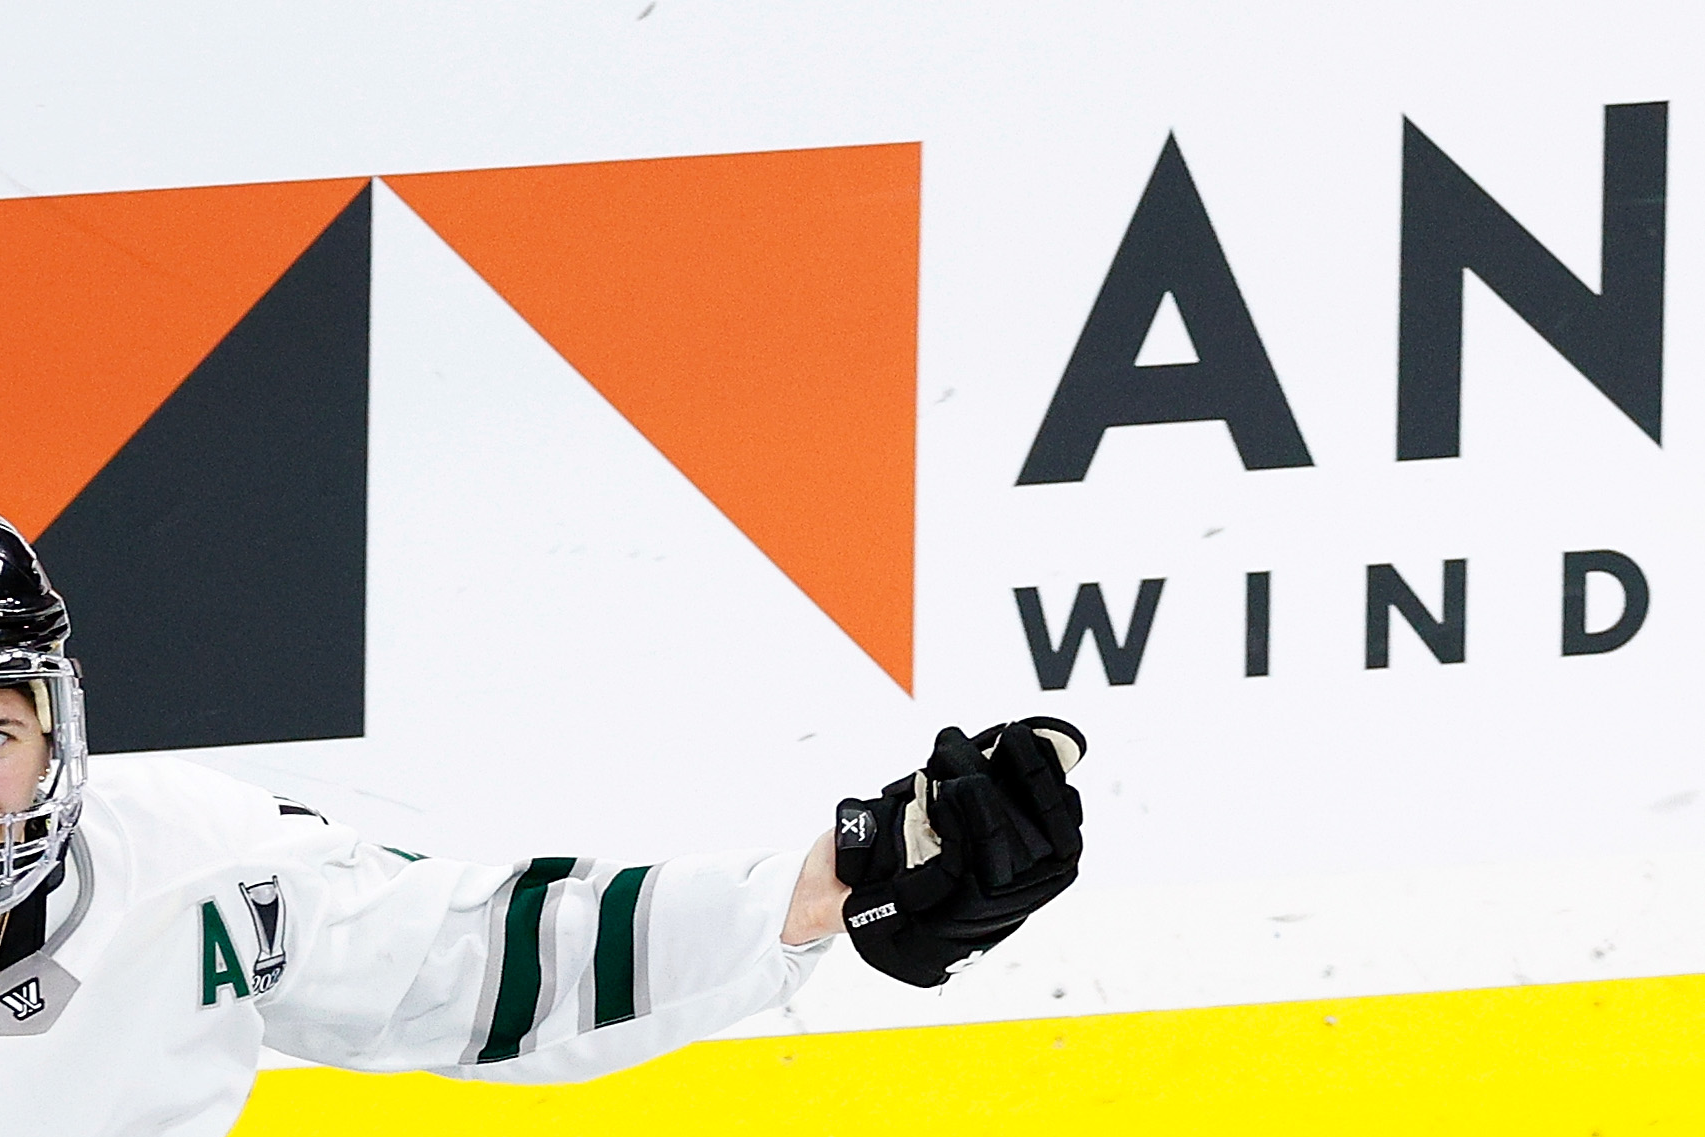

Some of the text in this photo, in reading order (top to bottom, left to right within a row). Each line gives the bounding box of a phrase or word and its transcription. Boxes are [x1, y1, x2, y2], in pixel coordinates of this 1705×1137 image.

[1015, 101, 1669, 486] AN
[1013, 549, 1650, 691] WIND
[197, 896, 251, 1008] A
[848, 902, 898, 928] KELLER
